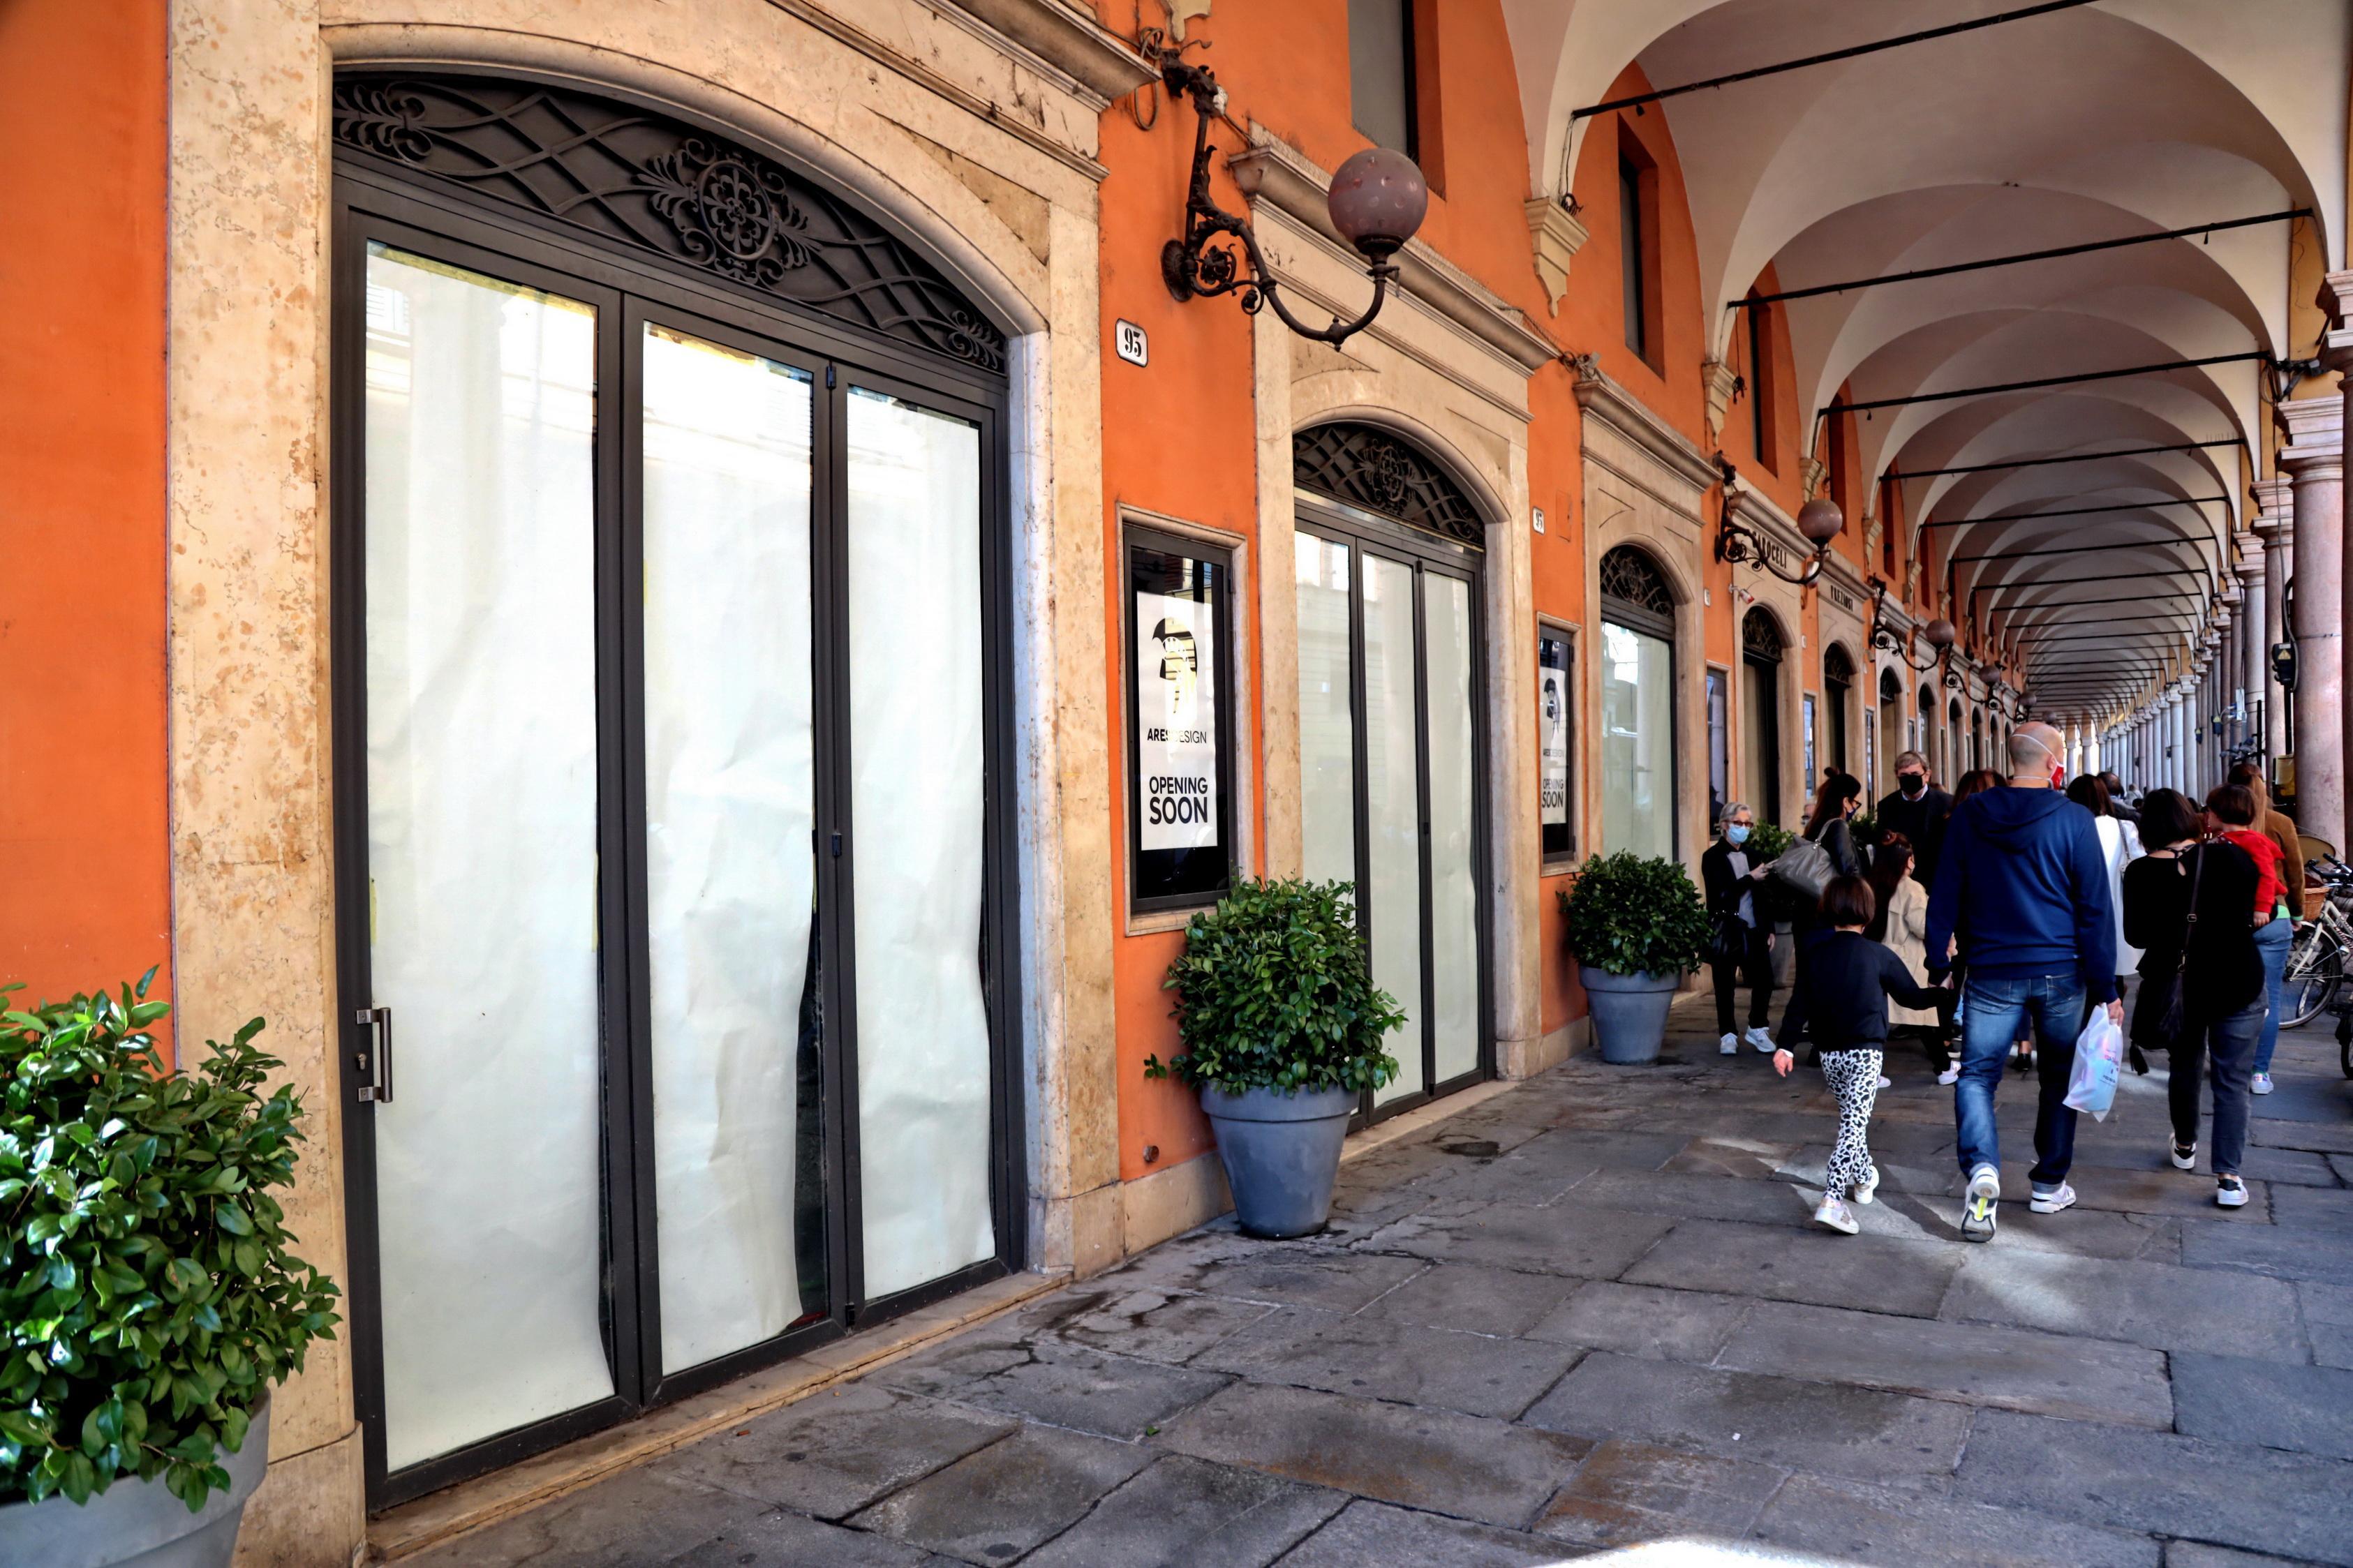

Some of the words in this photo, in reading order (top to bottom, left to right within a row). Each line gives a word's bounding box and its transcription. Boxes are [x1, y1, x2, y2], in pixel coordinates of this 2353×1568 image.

[1124, 328, 1141, 357] 95
[1173, 730, 1207, 743] ESIGN
[1149, 776, 1208, 794] OPENING
[1542, 791, 1564, 808] SOON
[1149, 796, 1208, 824] SOON
